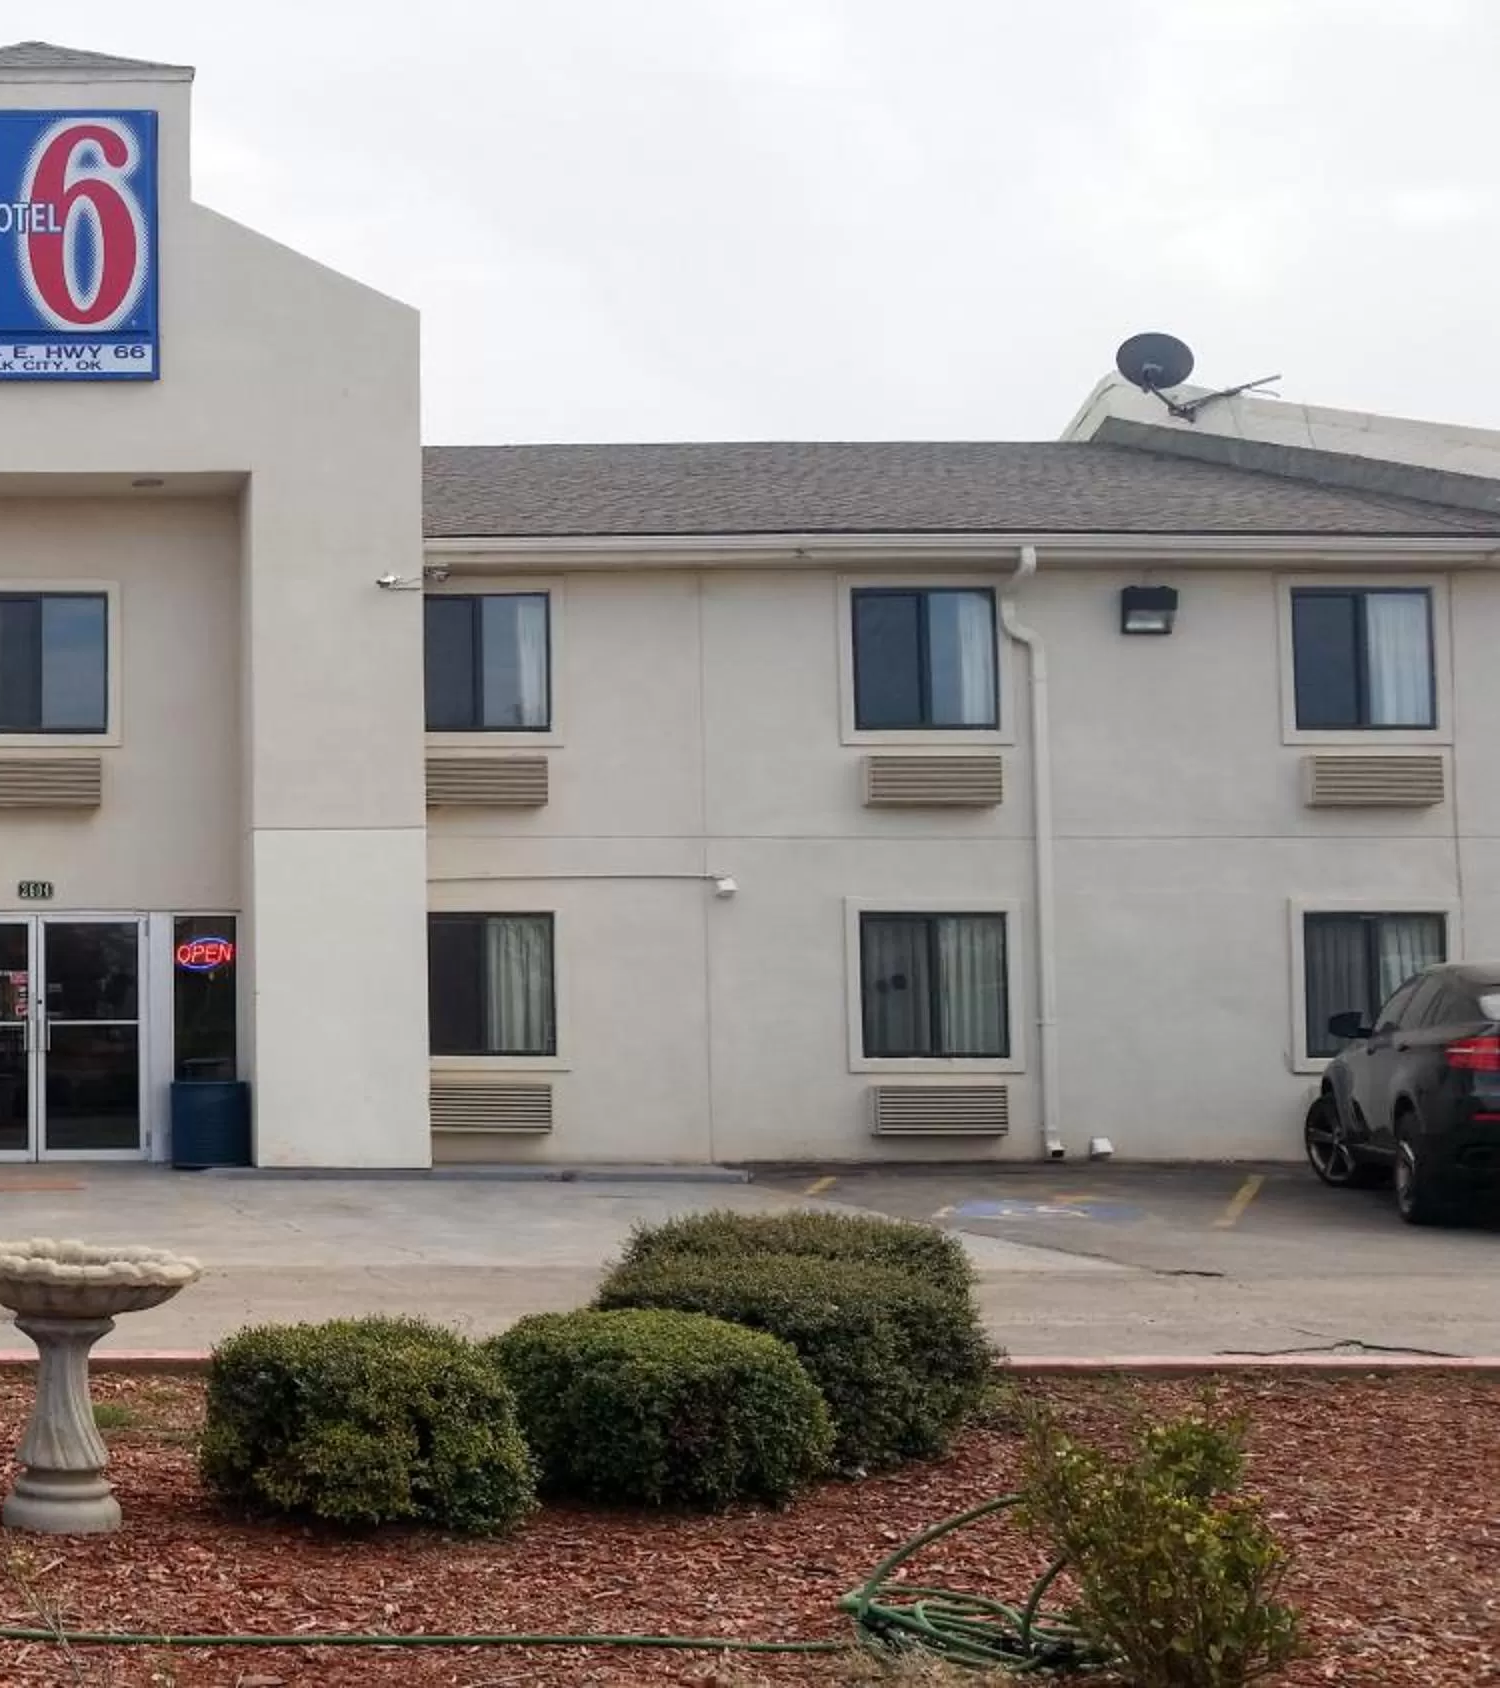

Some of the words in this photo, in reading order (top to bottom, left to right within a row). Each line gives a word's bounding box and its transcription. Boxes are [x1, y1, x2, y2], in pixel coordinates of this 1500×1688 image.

[23, 120, 143, 329] 6
[13, 345, 35, 360] E.
[45, 345, 102, 360] HWY
[113, 345, 146, 360] 66
[75, 360, 103, 371] OK
[177, 943, 233, 964] OPEN
